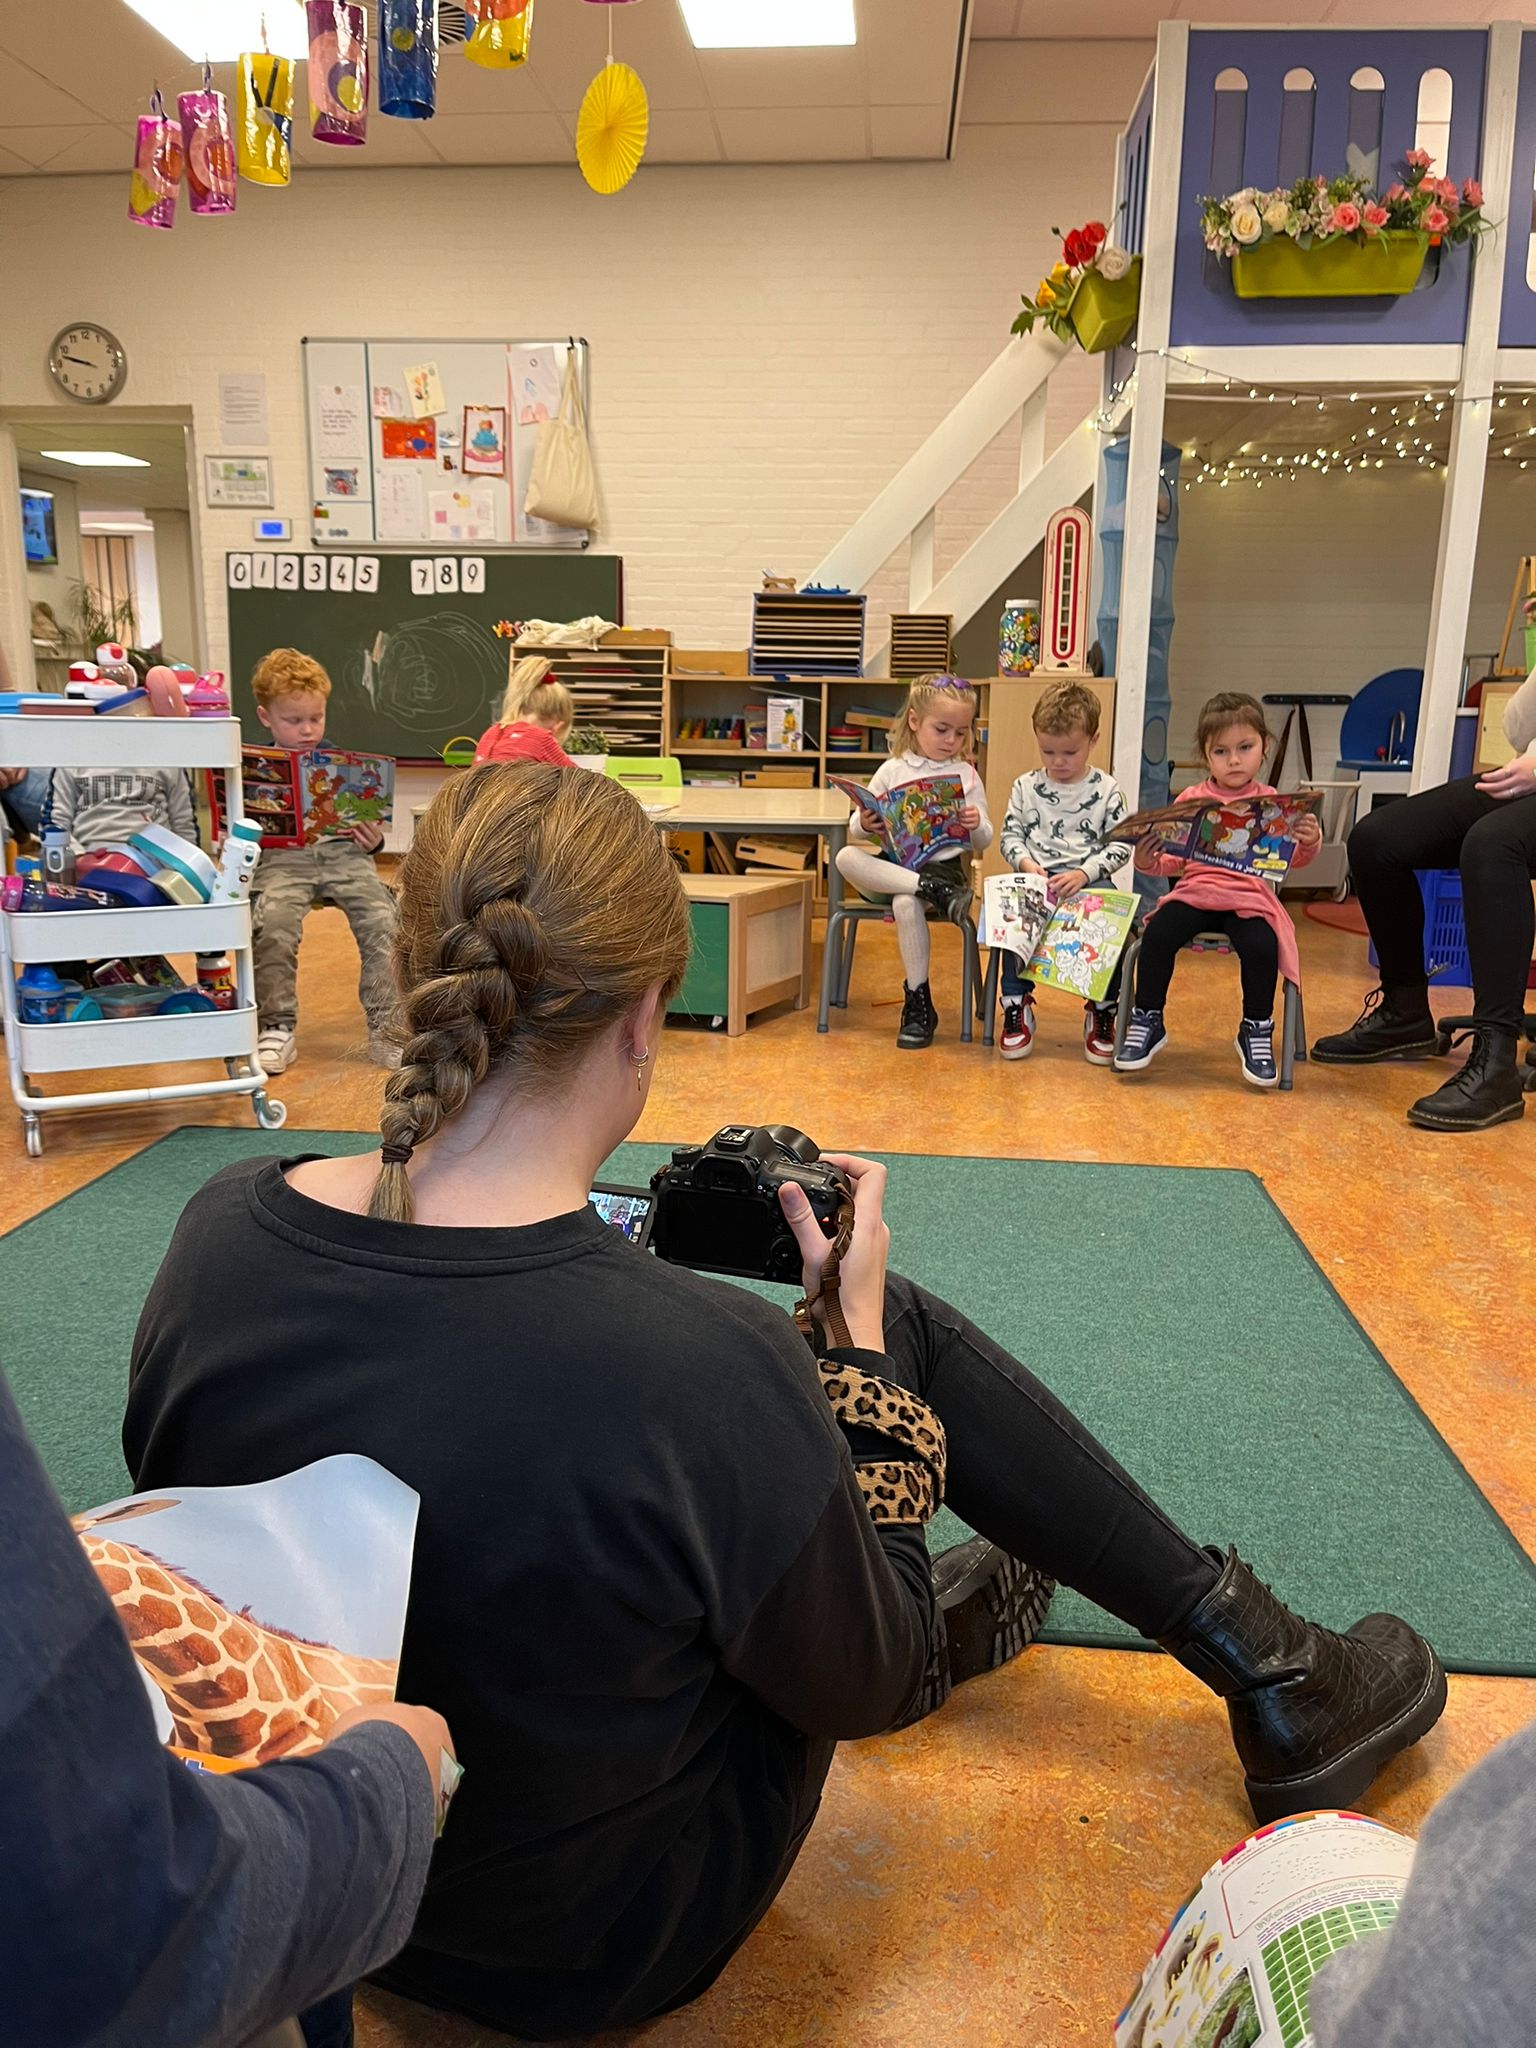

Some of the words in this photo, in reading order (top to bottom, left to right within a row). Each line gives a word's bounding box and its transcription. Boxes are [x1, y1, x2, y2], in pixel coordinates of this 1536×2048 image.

[69, 334, 77, 343] 11
[81, 329, 90, 340] 12
[60, 344, 69, 354] 10
[73, 383, 79, 393] 7
[233, 561, 246, 583] 0
[260, 560, 267, 579] 1
[282, 562, 295, 583] 2
[308, 562, 322, 583] 3
[336, 562, 347, 584] 4
[359, 564, 374, 585] 5
[417, 568, 428, 588] 7
[440, 563, 453, 586] 8
[467, 562, 479, 585] 9
